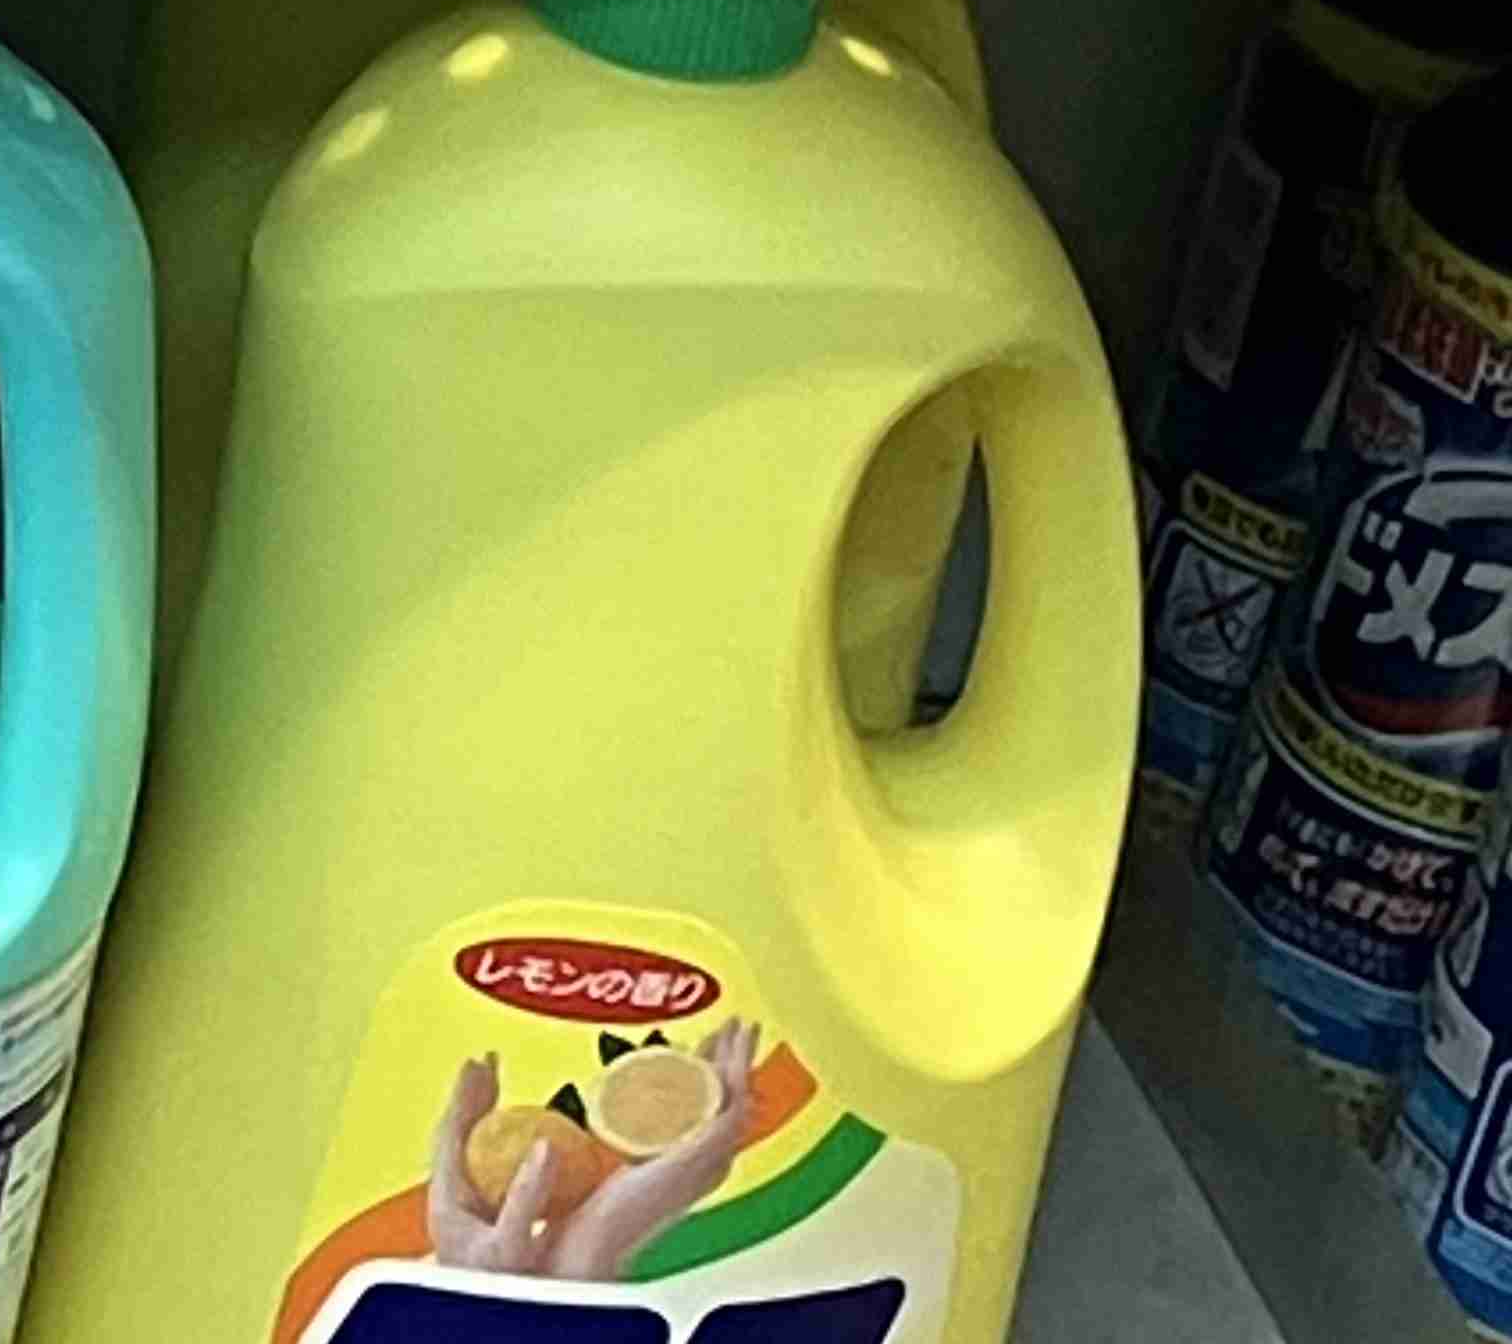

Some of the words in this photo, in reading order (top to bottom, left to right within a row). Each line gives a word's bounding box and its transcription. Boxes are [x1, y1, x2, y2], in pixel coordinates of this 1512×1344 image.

[475, 951, 708, 1010] レモンの香り
